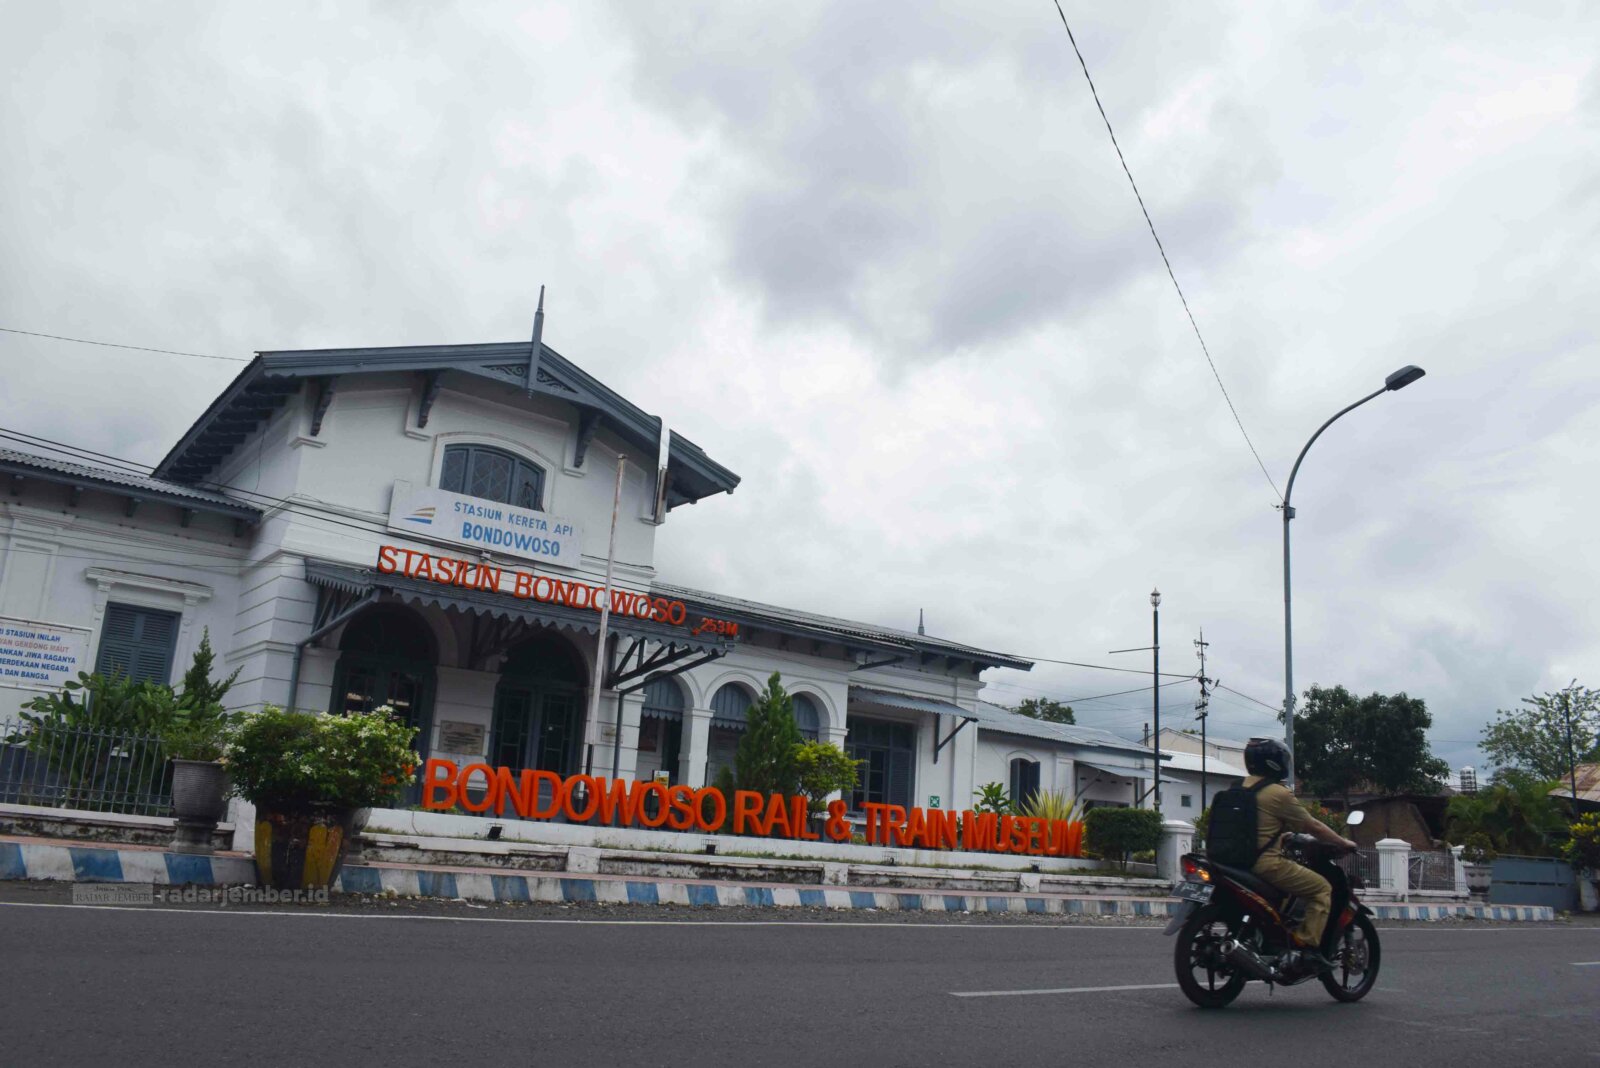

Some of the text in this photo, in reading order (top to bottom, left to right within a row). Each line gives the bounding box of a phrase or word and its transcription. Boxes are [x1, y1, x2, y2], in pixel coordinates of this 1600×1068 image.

[454, 501, 573, 537] STASIUN KERETA API
[462, 521, 560, 557] BONDOWOSO
[377, 545, 687, 625] STASIUN BONDOWOSO
[6, 630, 35, 640] STASIUN
[37, 634, 60, 642] INILAH
[41, 664, 69, 672] NEGARA
[44, 654, 76, 664] RAGANYA
[5, 669, 19, 677] DAN
[21, 672, 49, 680] BANGSA
[421, 758, 726, 832] BONDOWOSO
[732, 789, 819, 841] RAIL
[825, 799, 852, 841] &
[859, 802, 957, 850] TRAIN
[962, 809, 1083, 858] MUSEUM
